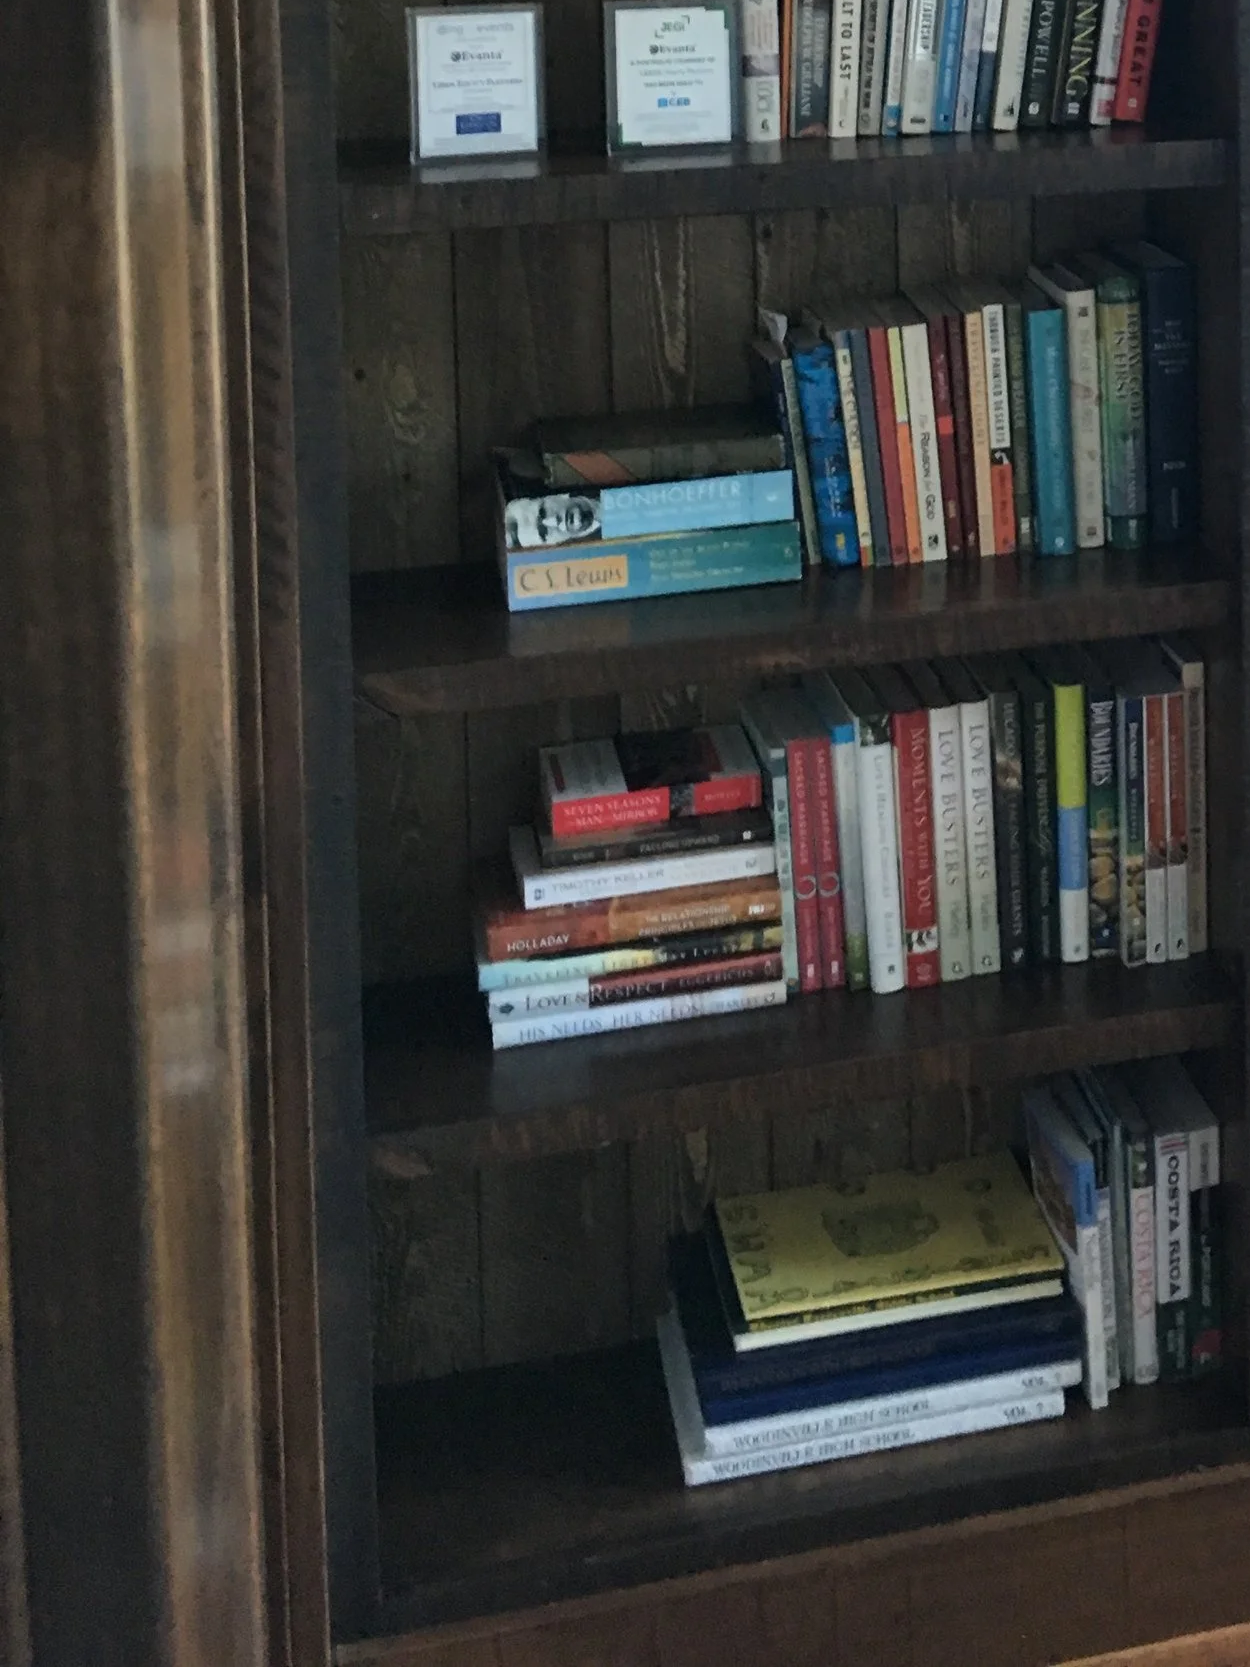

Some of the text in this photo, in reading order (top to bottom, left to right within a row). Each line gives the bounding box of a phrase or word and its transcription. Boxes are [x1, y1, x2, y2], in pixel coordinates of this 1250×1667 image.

[840, 21, 853, 39] TO
[1030, 0, 1054, 78] POWELL
[1128, 14, 1151, 88] GREAT
[839, 46, 852, 81] LAST
[990, 356, 1002, 396] PAINTED
[1113, 330, 1128, 402] IS FIRST
[993, 399, 1006, 443] DESERTS
[919, 431, 933, 477] REASON
[604, 480, 743, 511] BONHOEFFER
[968, 723, 988, 776] LOVE
[1003, 702, 1017, 755] LUCADO
[1033, 723, 1047, 775] PURPOSE
[1090, 701, 1114, 786] BOUNDARIES
[794, 750, 808, 799] SACRED
[815, 748, 828, 797] SACRED
[939, 729, 959, 782] LOVE
[909, 727, 933, 916] MOMENTS WITH YOU
[1036, 777, 1049, 824] DRIVEN
[941, 792, 961, 887] BUSTERS
[971, 787, 991, 881] BUSTERS
[552, 867, 666, 893] TIMOTHY KELLER
[1010, 888, 1023, 936] GIANTS
[506, 933, 570, 953] HOLLADAY
[525, 992, 569, 1010] LOVE
[589, 979, 666, 1003] RESPECT
[518, 1024, 546, 1042] HIS
[610, 1010, 651, 1026] HER
[1167, 1155, 1181, 1298] COSTA RICA
[1135, 1193, 1154, 1320] COSTA RICA
[732, 1399, 931, 1450] WOODINVILLE HIGH SCHOOL
[712, 1428, 916, 1476] WOODINVILLE HIGH SCHOOL
